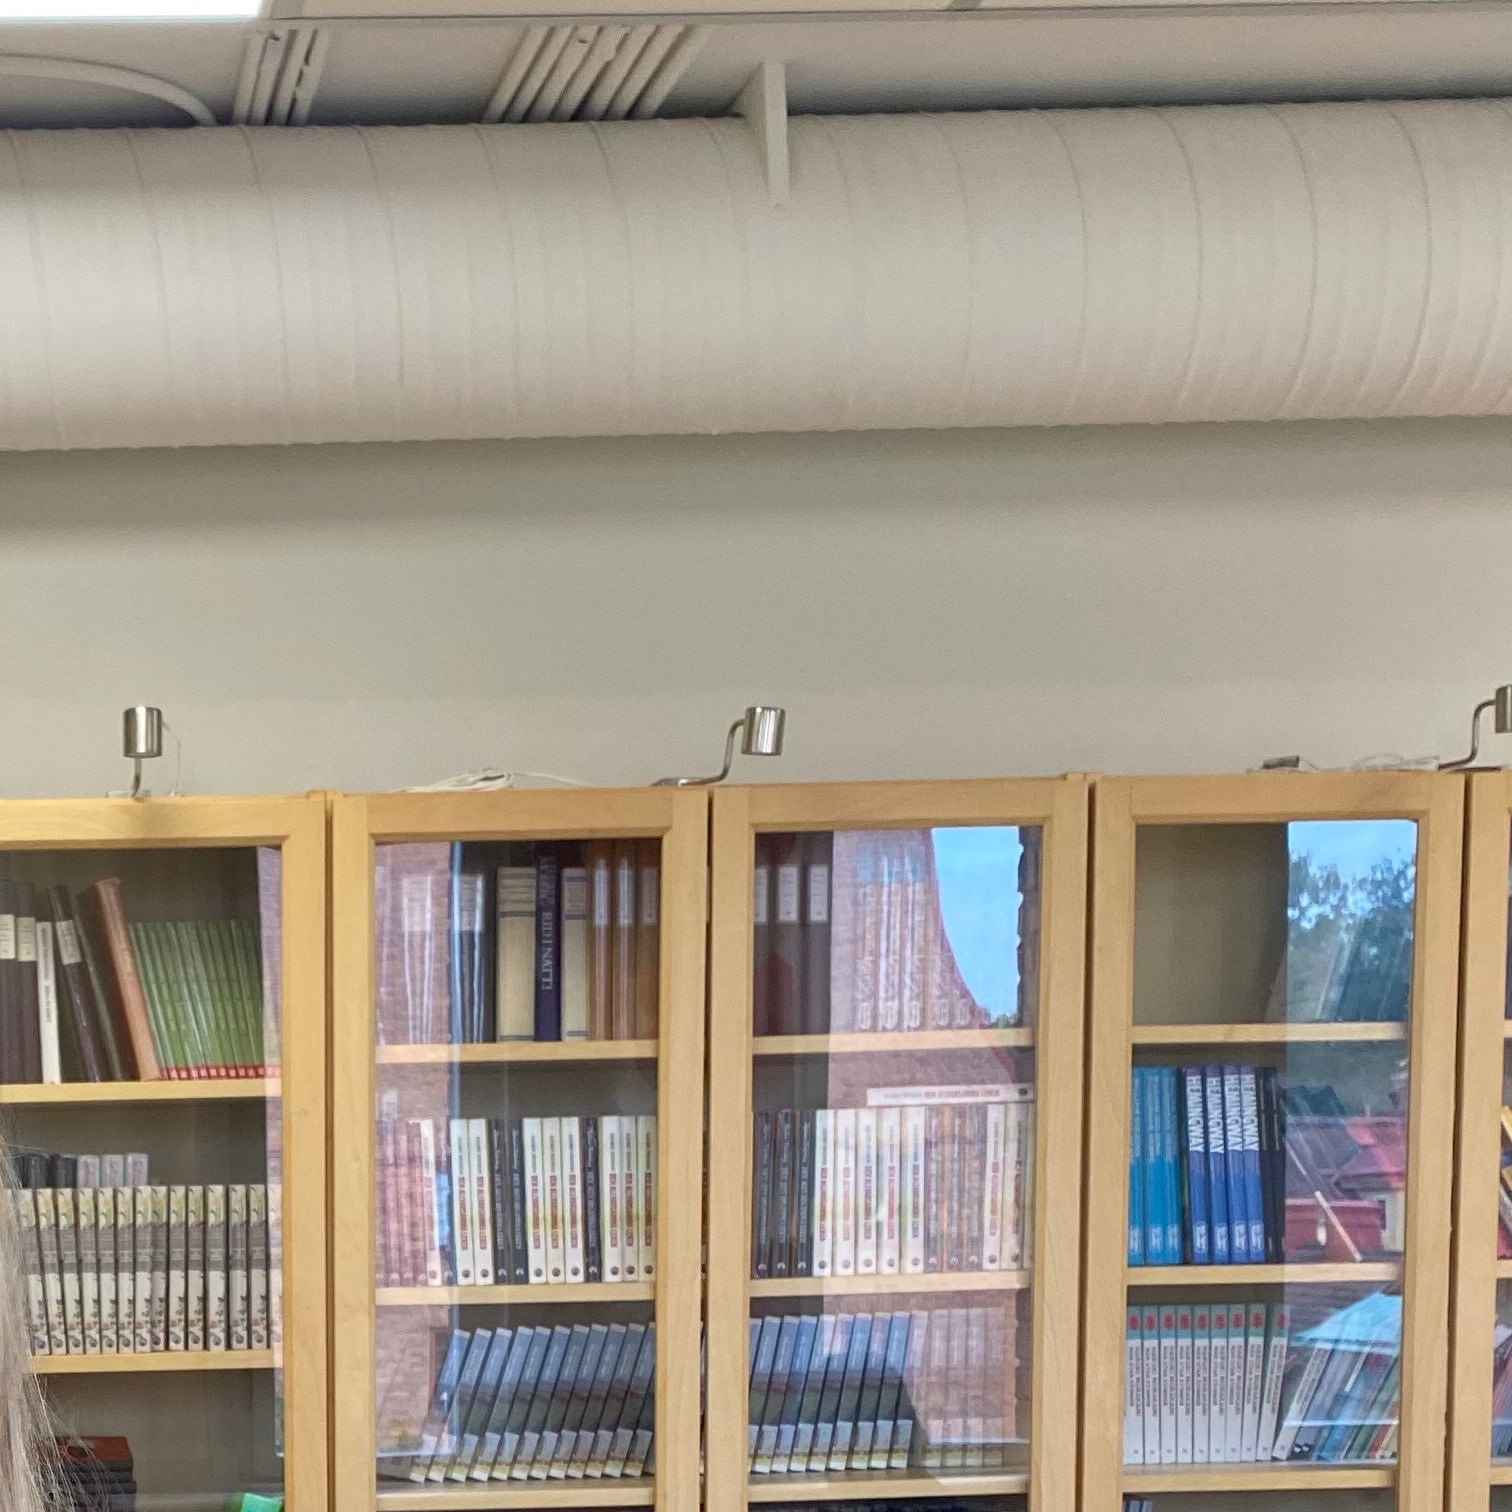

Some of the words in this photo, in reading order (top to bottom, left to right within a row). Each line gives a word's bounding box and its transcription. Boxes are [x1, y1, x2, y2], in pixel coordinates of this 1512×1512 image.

[542, 912, 553, 937] RID
[1186, 1076, 1204, 1151] HEMINGWAY
[1206, 1077, 1224, 1153] HEMINGWAY
[1224, 1075, 1242, 1151] HEMINGWAY
[1240, 1074, 1259, 1151] HEMINGWAY
